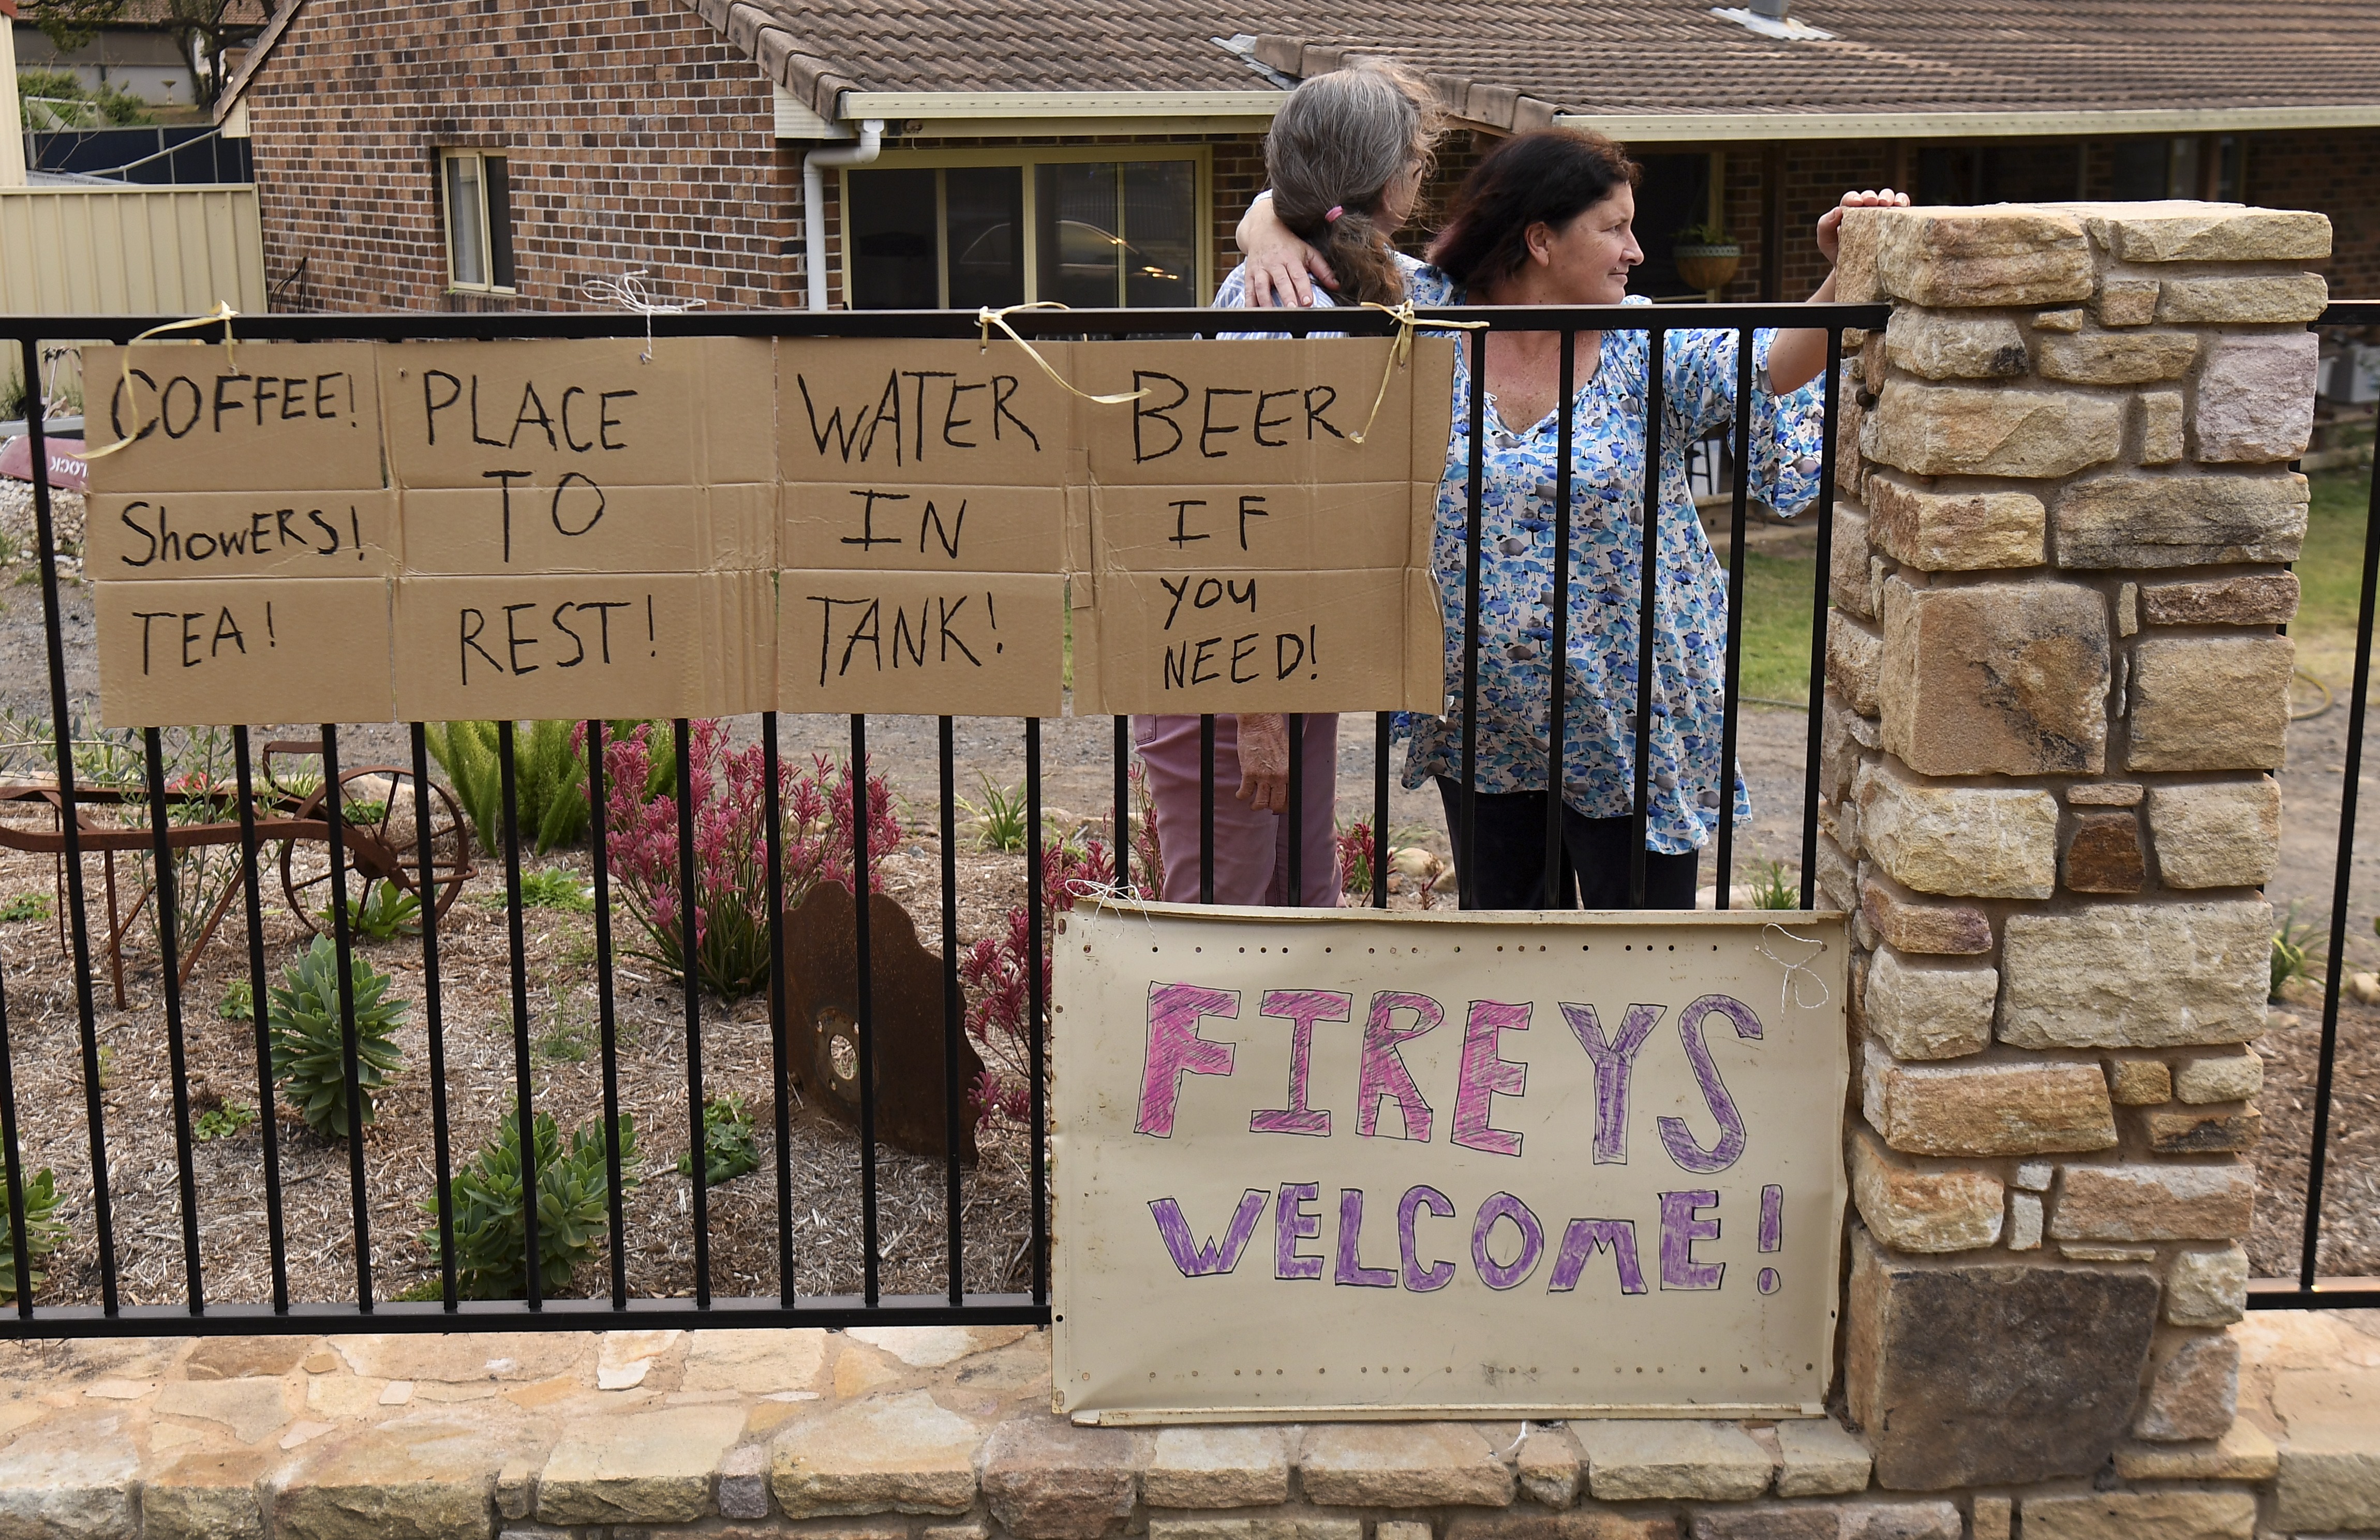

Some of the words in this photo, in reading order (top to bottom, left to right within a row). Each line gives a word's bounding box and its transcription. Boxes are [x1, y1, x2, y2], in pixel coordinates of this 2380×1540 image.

[111, 368, 355, 443] COFFEE!
[423, 369, 638, 453] PLACE
[797, 368, 1042, 468] WATER
[1132, 369, 1346, 465] BEER
[481, 469, 605, 563] TO
[839, 488, 967, 560] IN
[1168, 495, 1269, 551] IF
[132, 601, 275, 676] TEA!
[460, 594, 654, 686] REST!
[806, 591, 1003, 688] TANK!
[1163, 623, 1318, 691] NEED!
[1133, 980, 1763, 1174] FIREYS
[1147, 1181, 1783, 1295] WELCOME!
